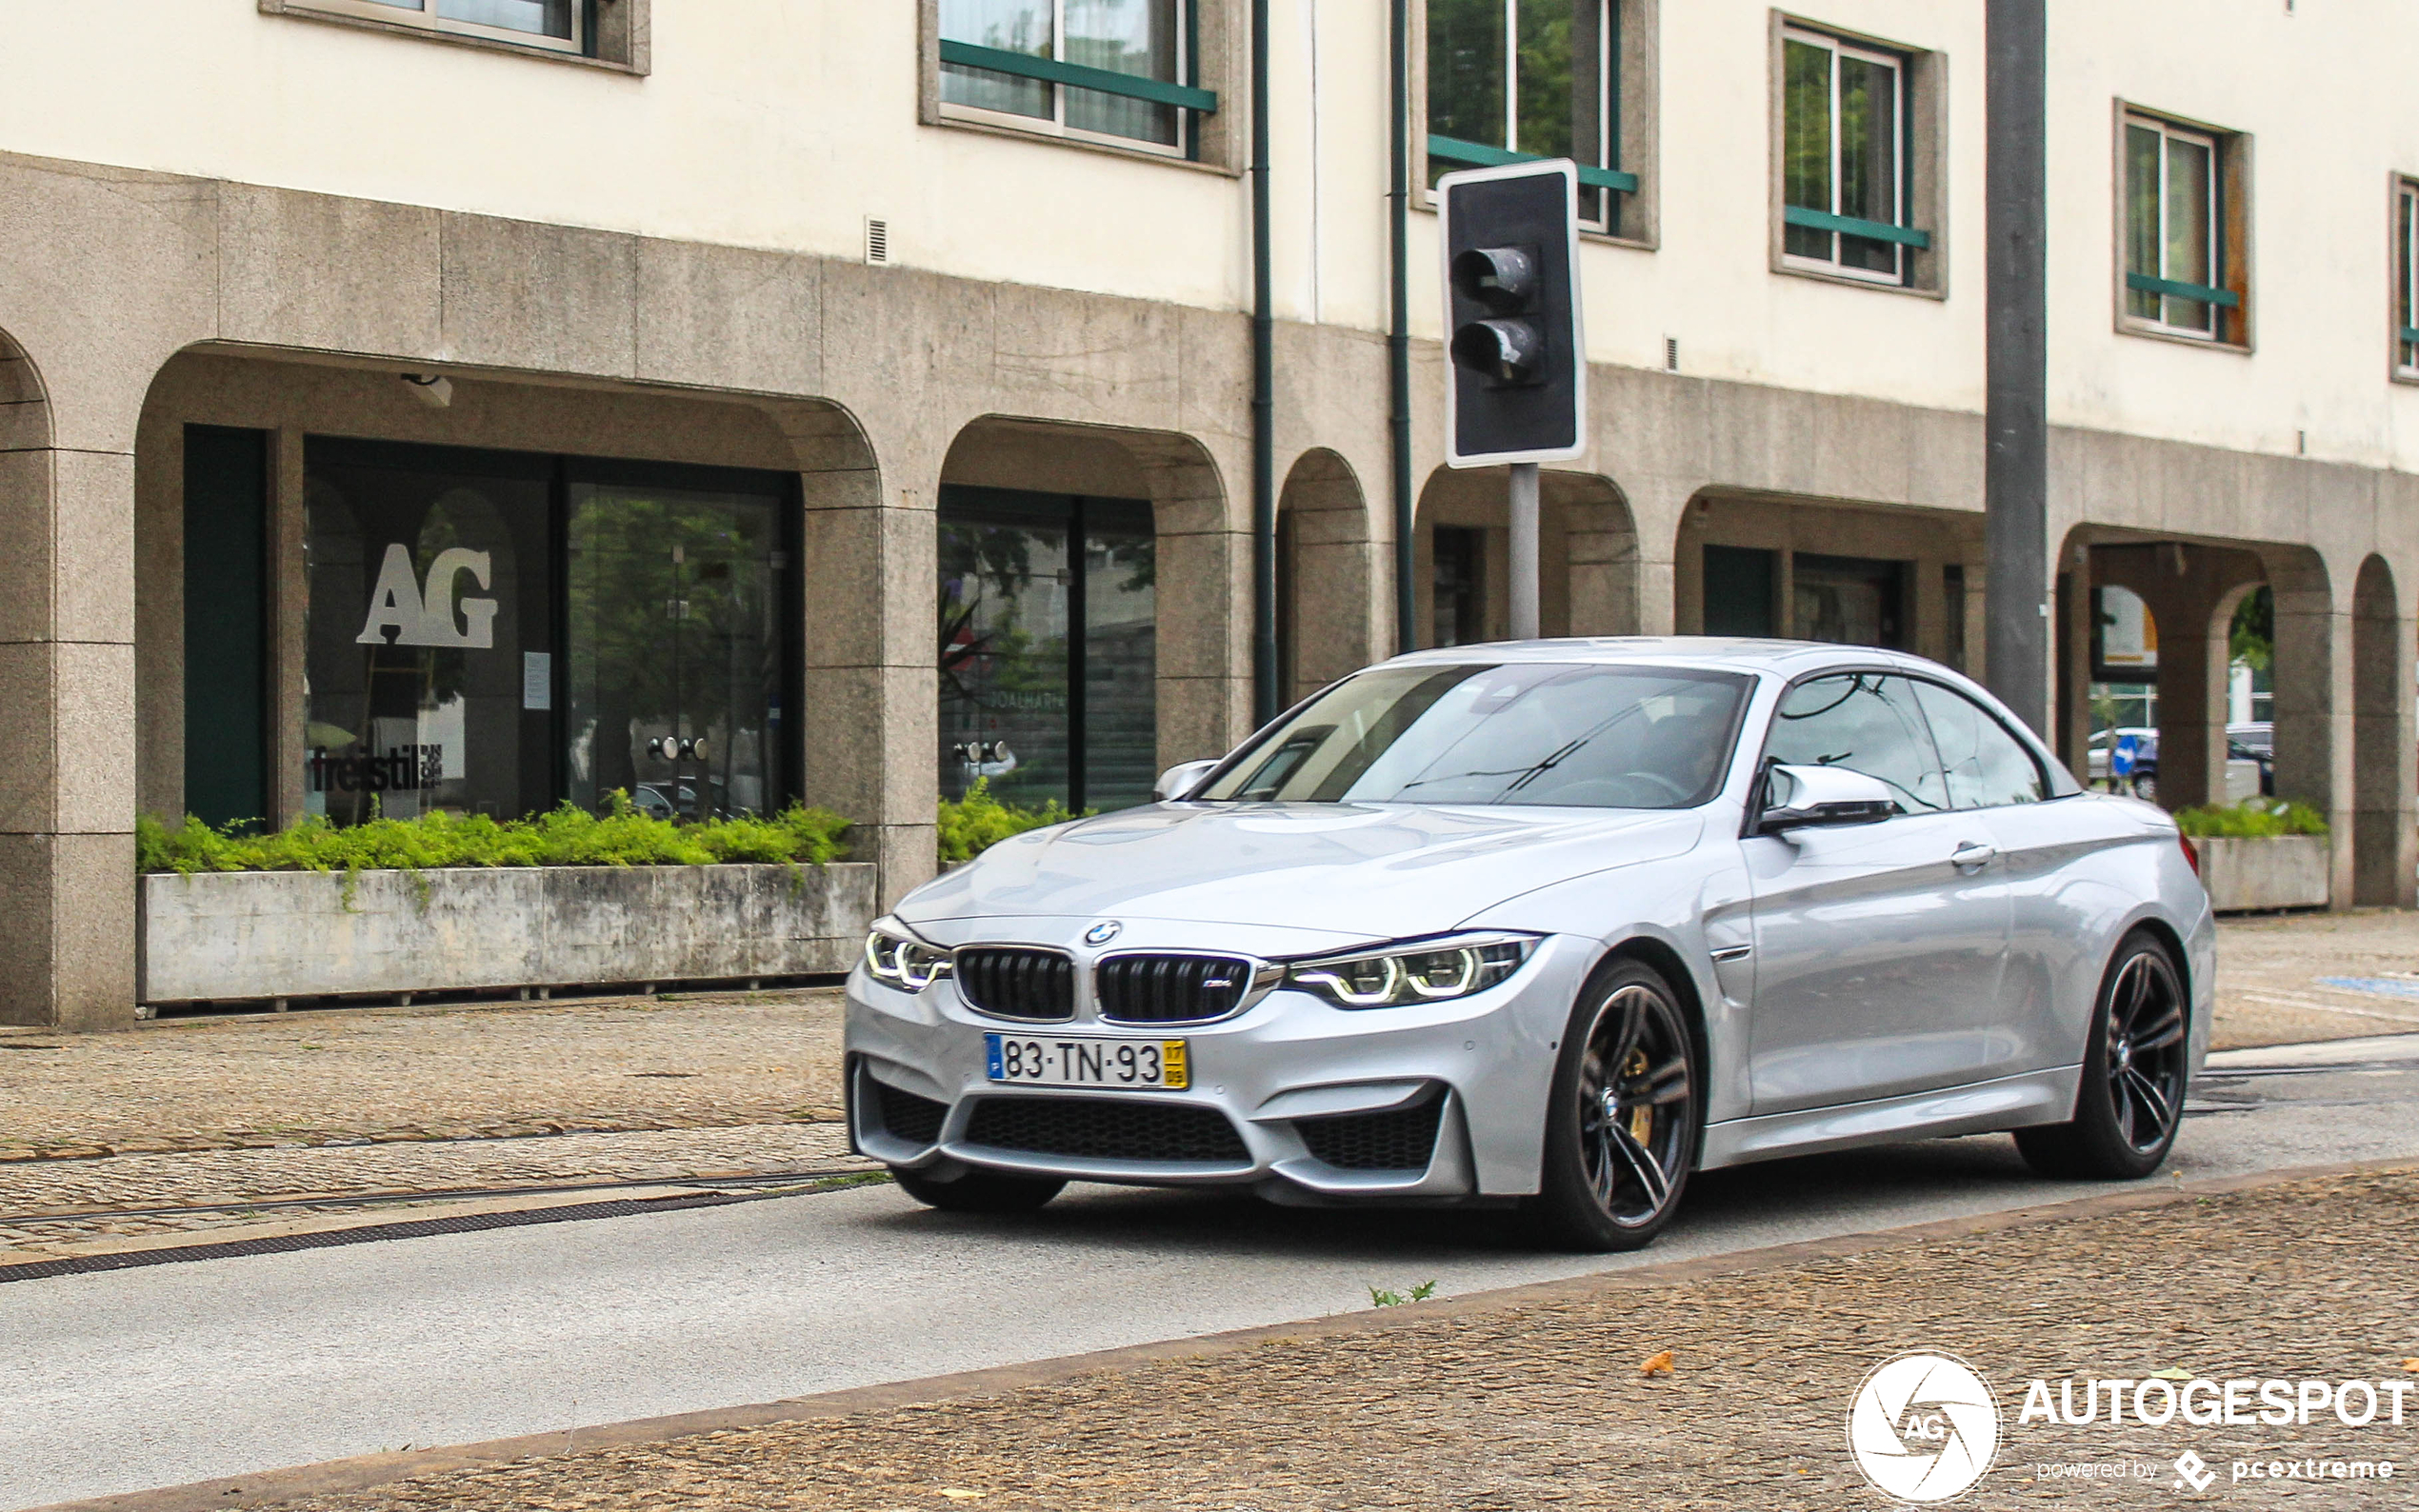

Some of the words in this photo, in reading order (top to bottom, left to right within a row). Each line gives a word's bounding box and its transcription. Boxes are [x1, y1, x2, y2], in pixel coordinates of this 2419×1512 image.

[356, 543, 498, 648] AG
[311, 745, 418, 791] freistil
[1203, 979, 1233, 987] M4
[1005, 1041, 1161, 1084] 83-TN-93
[1166, 1045, 1182, 1060] 17
